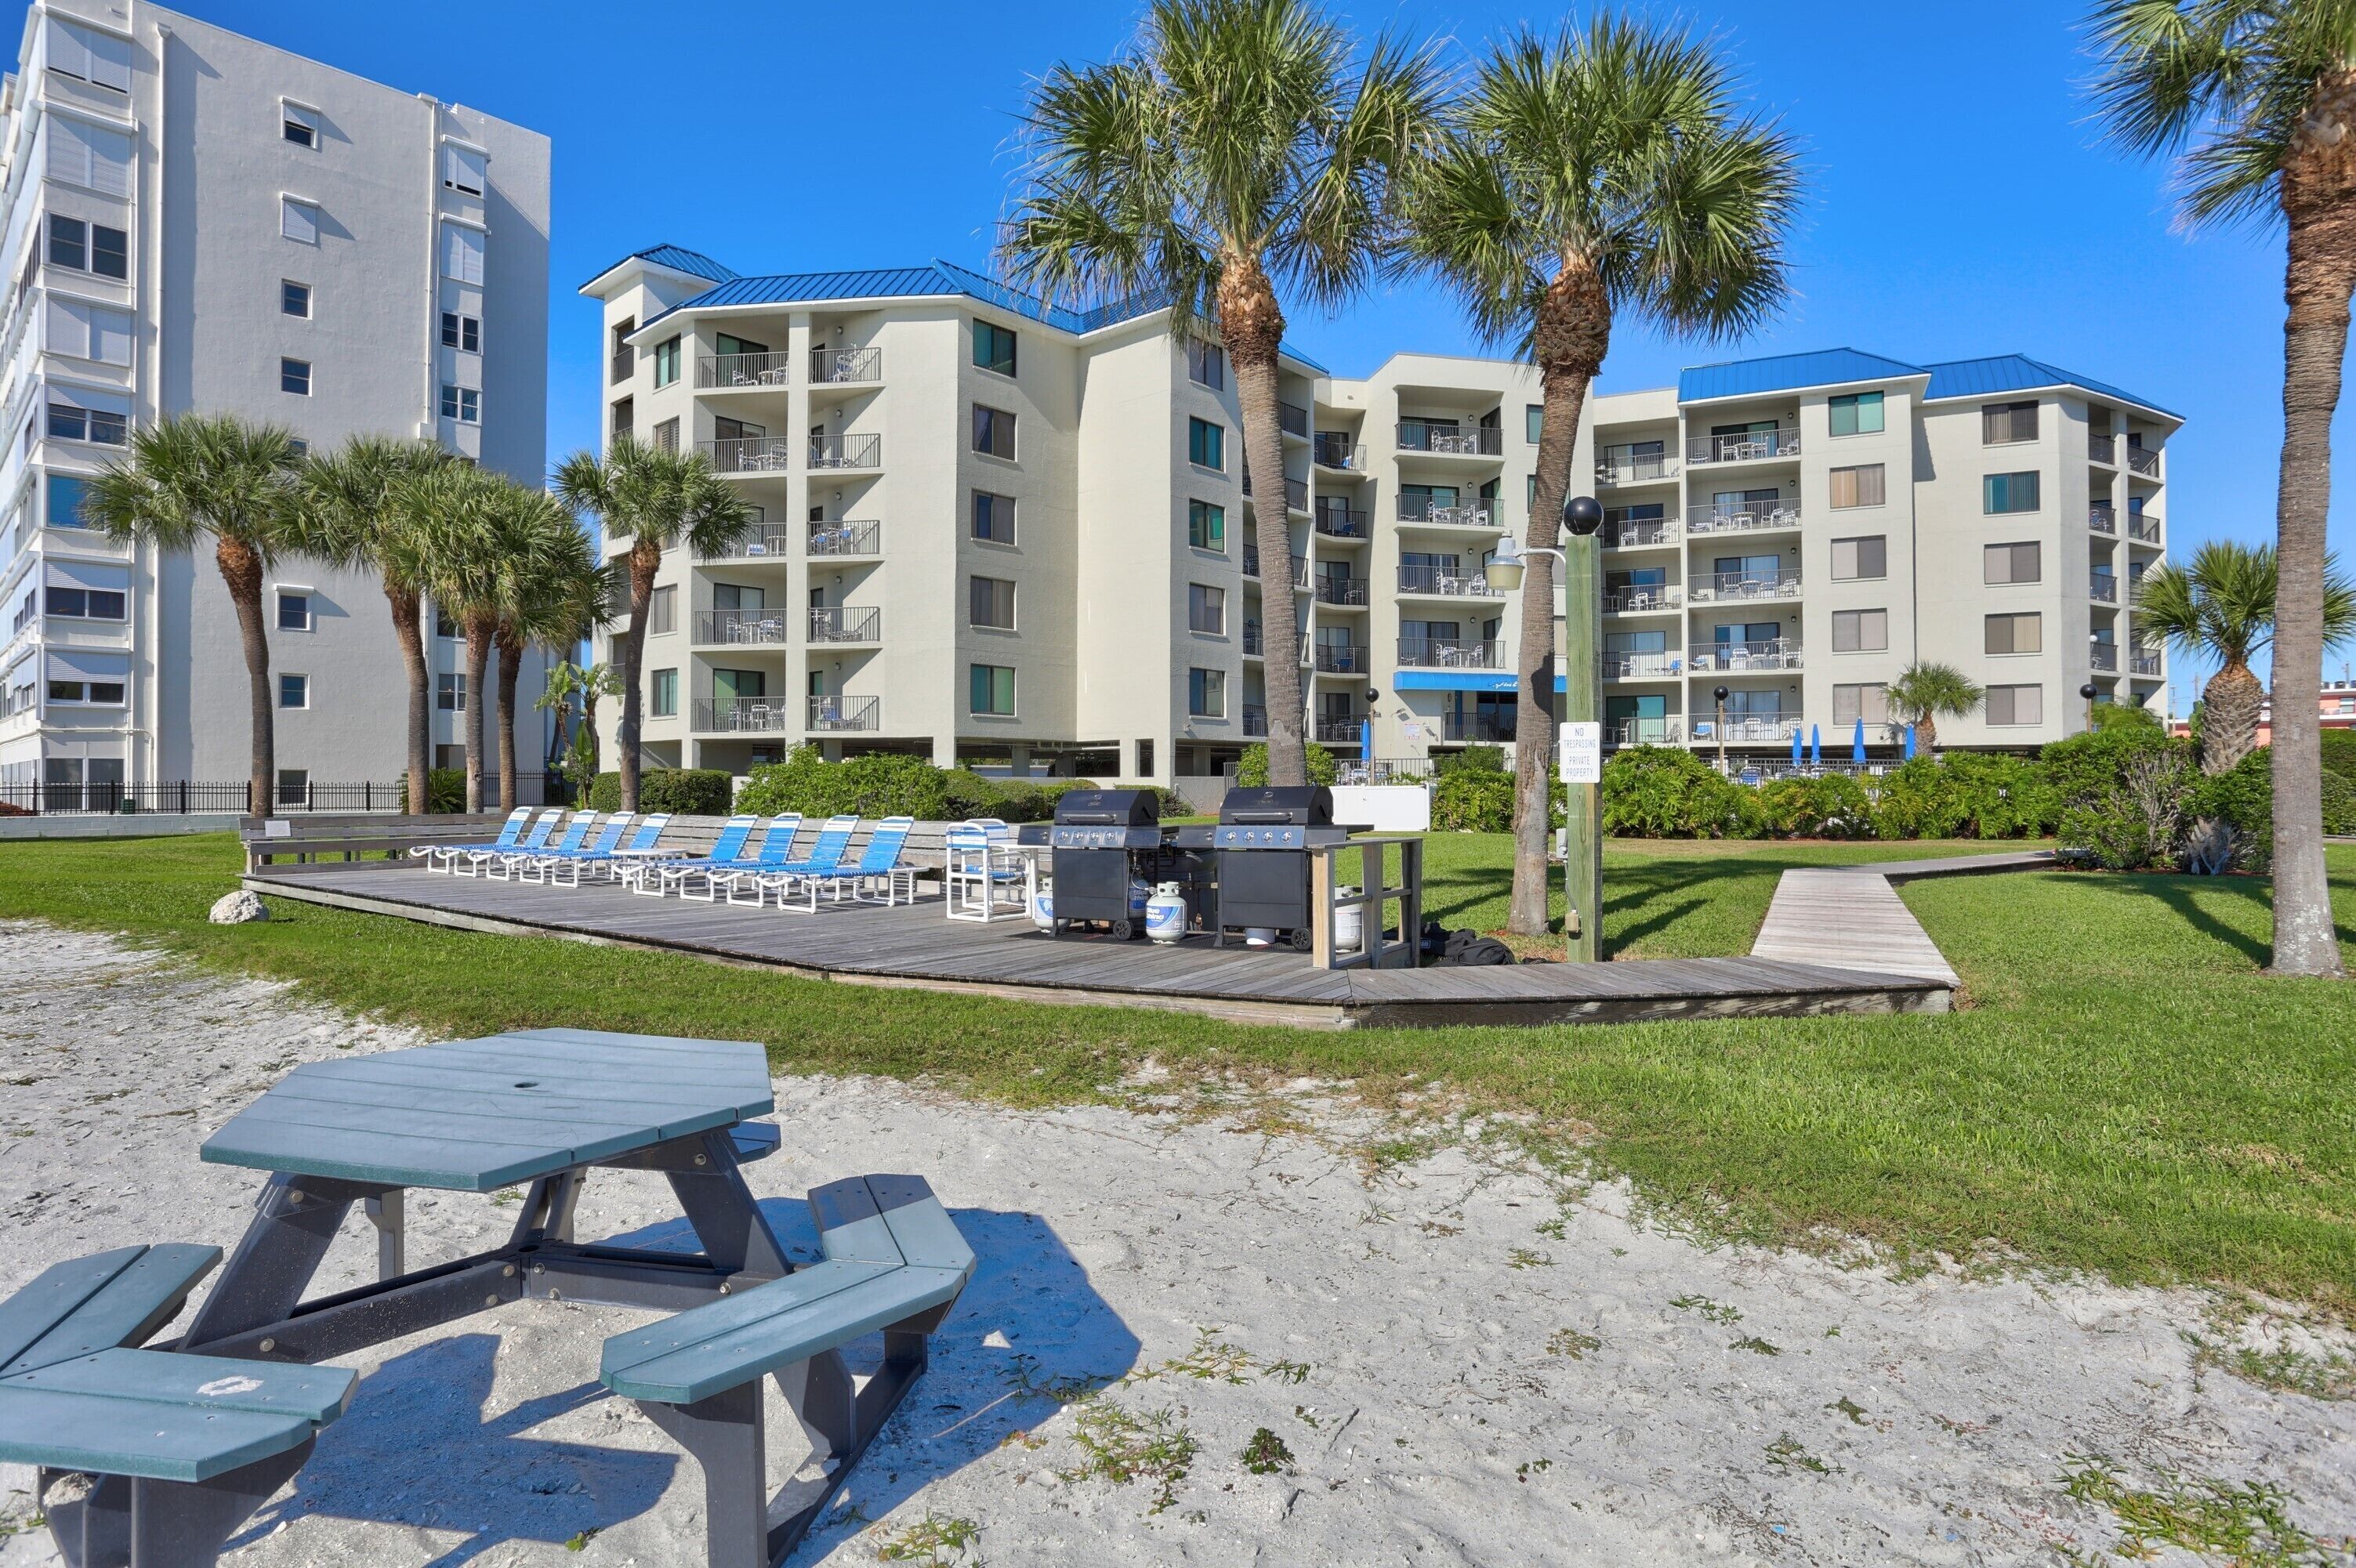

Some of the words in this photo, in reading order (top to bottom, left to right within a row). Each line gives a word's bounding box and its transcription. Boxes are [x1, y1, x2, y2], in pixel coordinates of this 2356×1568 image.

[1575, 727, 1584, 737] NO
[1564, 740, 1596, 748] TRESPASSING
[1569, 756, 1590, 765] PRIVATE
[1566, 768, 1593, 777] PROPERTY
